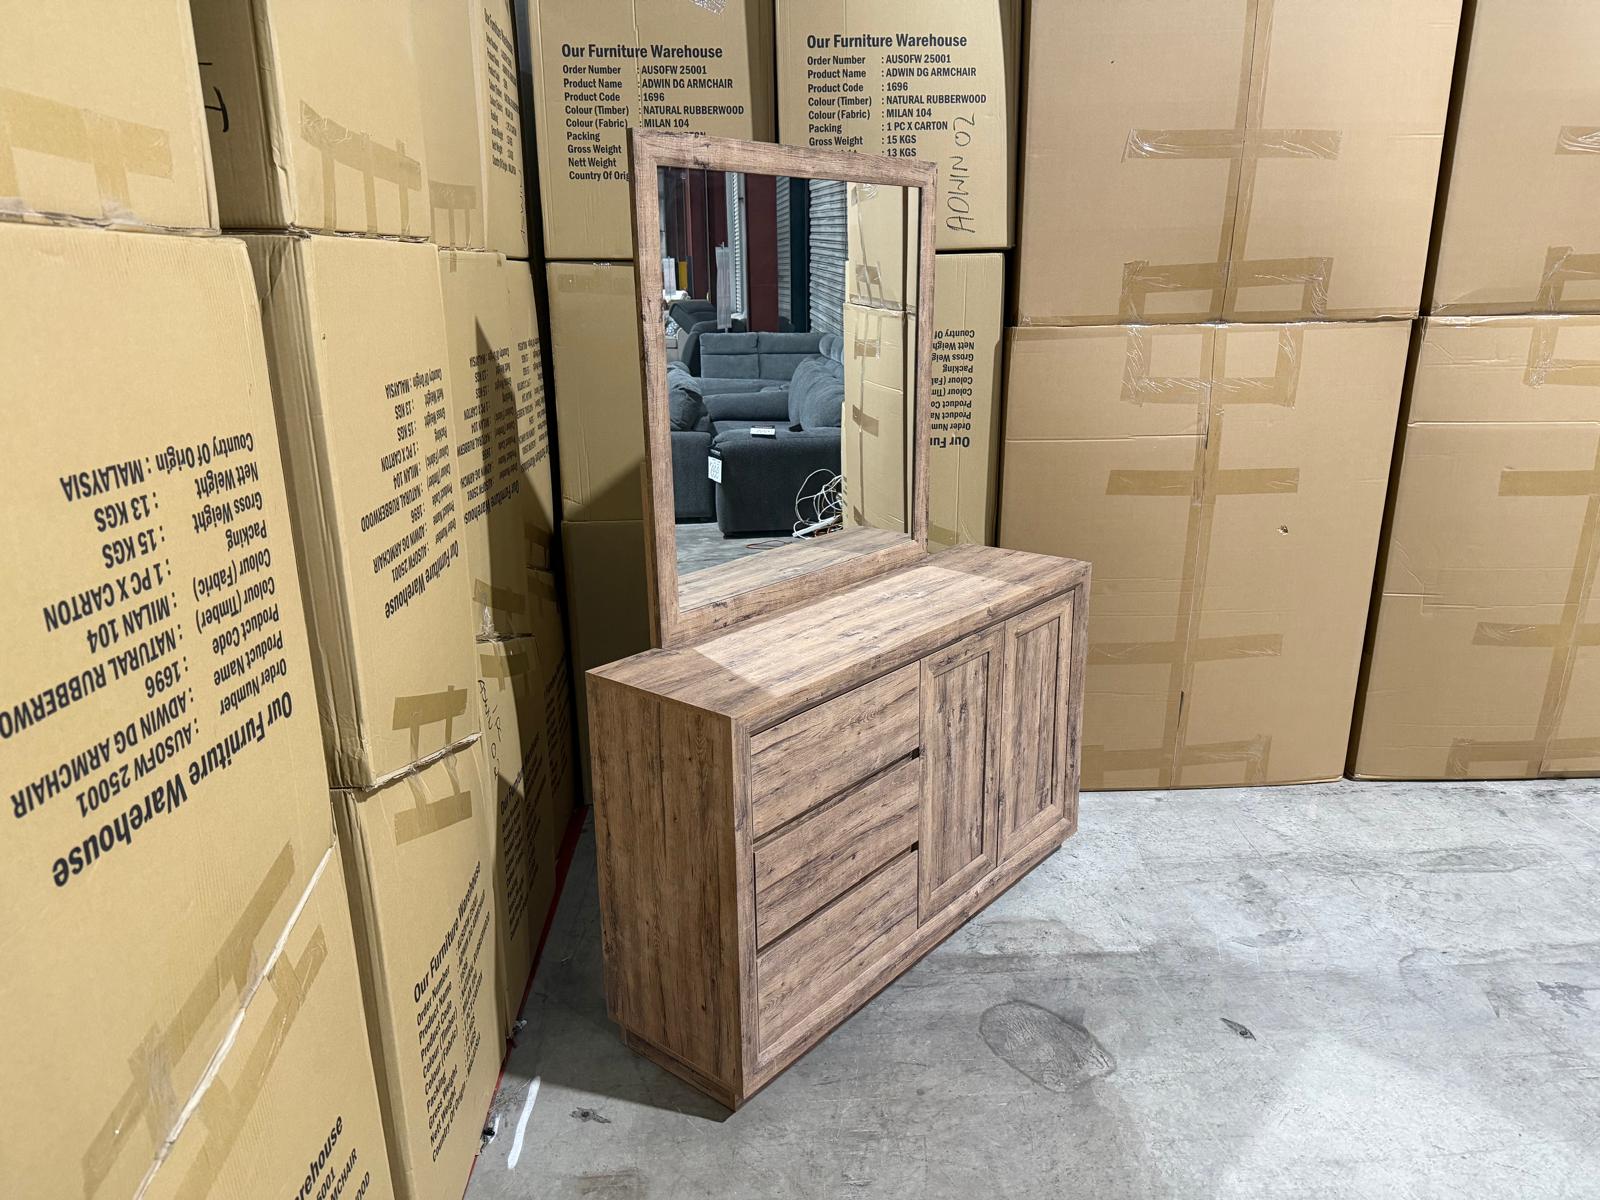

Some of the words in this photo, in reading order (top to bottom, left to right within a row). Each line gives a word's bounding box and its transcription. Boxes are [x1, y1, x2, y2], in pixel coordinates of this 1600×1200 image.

[561, 43, 585, 57] Our
[588, 44, 647, 58] Furniture
[650, 44, 722, 58] Warehouse
[807, 34, 830, 48] Our
[833, 33, 892, 48] Furniture
[895, 33, 967, 47] Warehouse
[562, 64, 586, 74] Order
[588, 64, 621, 74] Number
[641, 65, 678, 74] AUSOFW
[679, 65, 707, 74] 25001
[807, 56, 831, 65] Order
[832, 55, 865, 64] Number
[885, 54, 922, 64] AUSOFW
[923, 54, 951, 63] 25001
[807, 69, 840, 79] Product
[842, 68, 866, 78] Name
[885, 67, 914, 77] ADWIN
[916, 67, 929, 77] DG
[930, 67, 976, 76] ARMCHAIR
[563, 78, 596, 88] Product
[598, 78, 622, 88] Name
[641, 78, 670, 88] ADWIN
[672, 78, 685, 88] DG
[686, 78, 733, 88] ARMCHAIR
[564, 92, 597, 101] Product
[598, 92, 620, 102] Code
[643, 92, 664, 102] 1696
[807, 83, 840, 93] Product
[842, 82, 863, 92] Code
[886, 81, 908, 91] 1696
[565, 105, 592, 114] Colour
[594, 105, 629, 116] (Timber)
[643, 105, 682, 115] NATURAL
[683, 105, 744, 114] RUBBERWOOD
[808, 97, 835, 106] Colour
[837, 96, 872, 107] (Timber)
[886, 95, 924, 104] NATURAL
[926, 94, 986, 104] RUBBERWOOD
[808, 110, 835, 120] Colour
[837, 109, 870, 120] (Fabric)
[886, 108, 913, 118] MILAN
[916, 108, 932, 117] 104
[565, 118, 593, 127] Colour
[594, 118, 628, 129] (Fabric)
[644, 118, 671, 127] MILAN
[673, 118, 689, 128] 104
[566, 131, 600, 142] Packing
[808, 123, 842, 134] Packing
[887, 122, 892, 131] 1
[894, 121, 905, 131] PC
[906, 121, 912, 130] X
[914, 120, 948, 130] CARTON
[567, 144, 591, 153] Gross
[592, 144, 622, 155] Weight
[808, 137, 832, 146] Gross
[834, 136, 863, 147] Weight
[886, 135, 897, 144] 15
[899, 134, 916, 144] KGS
[886, 148, 897, 157] 13
[899, 147, 916, 157] KGS
[568, 157, 586, 167] Nett
[587, 157, 616, 169] Weight
[569, 170, 601, 182] Country
[602, 170, 612, 180] Of
[614, 170, 628, 181] Orig
[933, 341, 956, 350] Weigh
[934, 331, 943, 339] Of
[945, 329, 975, 338] Country
[932, 353, 950, 362] Weig
[943, 364, 973, 373] Packing
[197, 443, 211, 466] Of
[212, 432, 253, 458] Country
[950, 437, 970, 448] Our
[155, 446, 195, 474] Origin
[235, 461, 258, 486] Nett
[59, 459, 144, 501] MALAYSIA
[194, 469, 236, 499] Weight
[94, 501, 128, 532] KGS
[130, 494, 150, 520] 13
[233, 491, 262, 514] Gross
[192, 502, 234, 533] Weight
[137, 528, 157, 555] 15
[225, 519, 267, 551] Packing
[102, 536, 136, 568] KGS
[239, 548, 271, 576] Colour
[130, 567, 152, 595] PC
[153, 562, 163, 585] 1
[192, 559, 237, 602] (Fabric)
[116, 576, 129, 601] X
[244, 576, 275, 604] Colour
[384, 573, 425, 618] Warehouse
[43, 583, 114, 631] CARTON
[122, 595, 170, 636] MILAN
[195, 589, 242, 634] (Timber)
[240, 603, 279, 640] Product
[86, 618, 119, 654] 104
[212, 626, 240, 655] Code
[245, 630, 283, 669] Product
[107, 628, 176, 680] NATURAL
[144, 661, 181, 698] 1696
[213, 655, 245, 686] Name
[260, 658, 286, 686] Order
[0, 664, 106, 739] RUBBERWO
[220, 676, 260, 715] Number
[267, 691, 292, 726] Our
[139, 691, 186, 739] ADWIN
[113, 722, 138, 754] DG
[134, 722, 191, 781] AUSOFW
[188, 711, 265, 785] Furniture
[10, 738, 109, 818] ARMCHAIR
[76, 764, 130, 817] 25001
[52, 773, 187, 887] Warehouse
[295, 1116, 343, 1200] rehouse
[316, 1166, 335, 1200] 5001
[330, 1148, 358, 1200] MCHAIR
